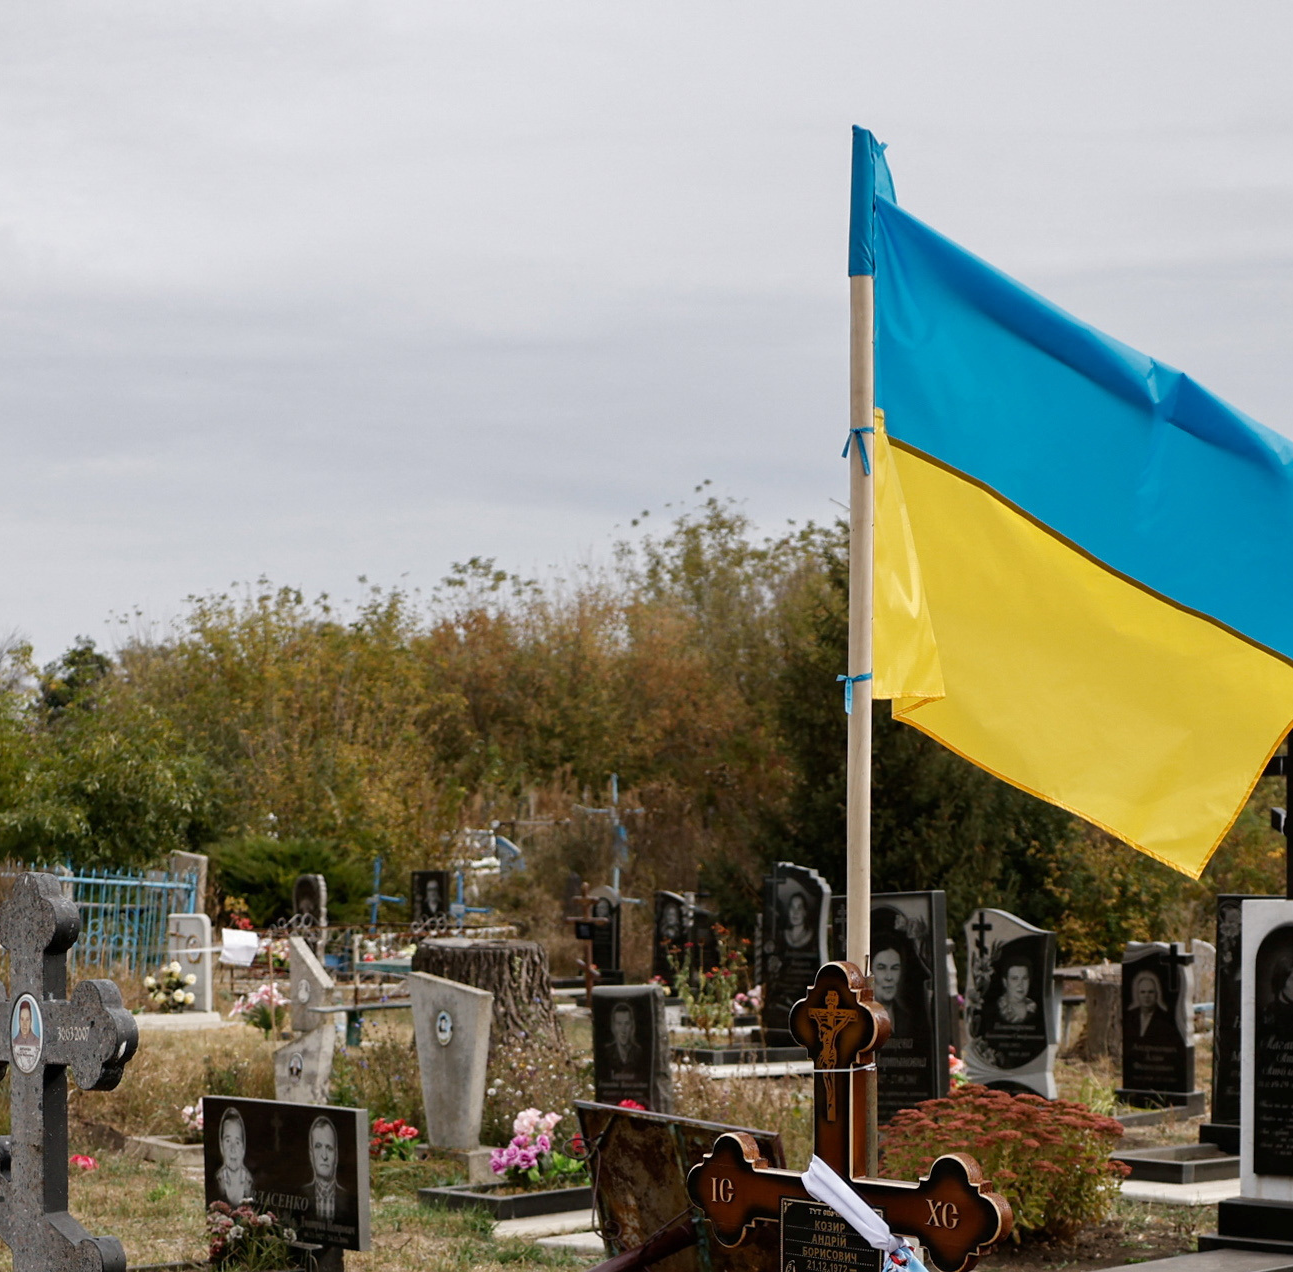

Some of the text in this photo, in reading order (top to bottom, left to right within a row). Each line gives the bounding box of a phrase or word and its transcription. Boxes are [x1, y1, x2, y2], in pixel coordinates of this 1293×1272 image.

[809, 1207, 822, 1216] ТУТ
[814, 1220, 846, 1233] КОЗИР
[811, 1233, 847, 1247] АНДРІЙ
[802, 1246, 858, 1263] БОРИСОВИЧ
